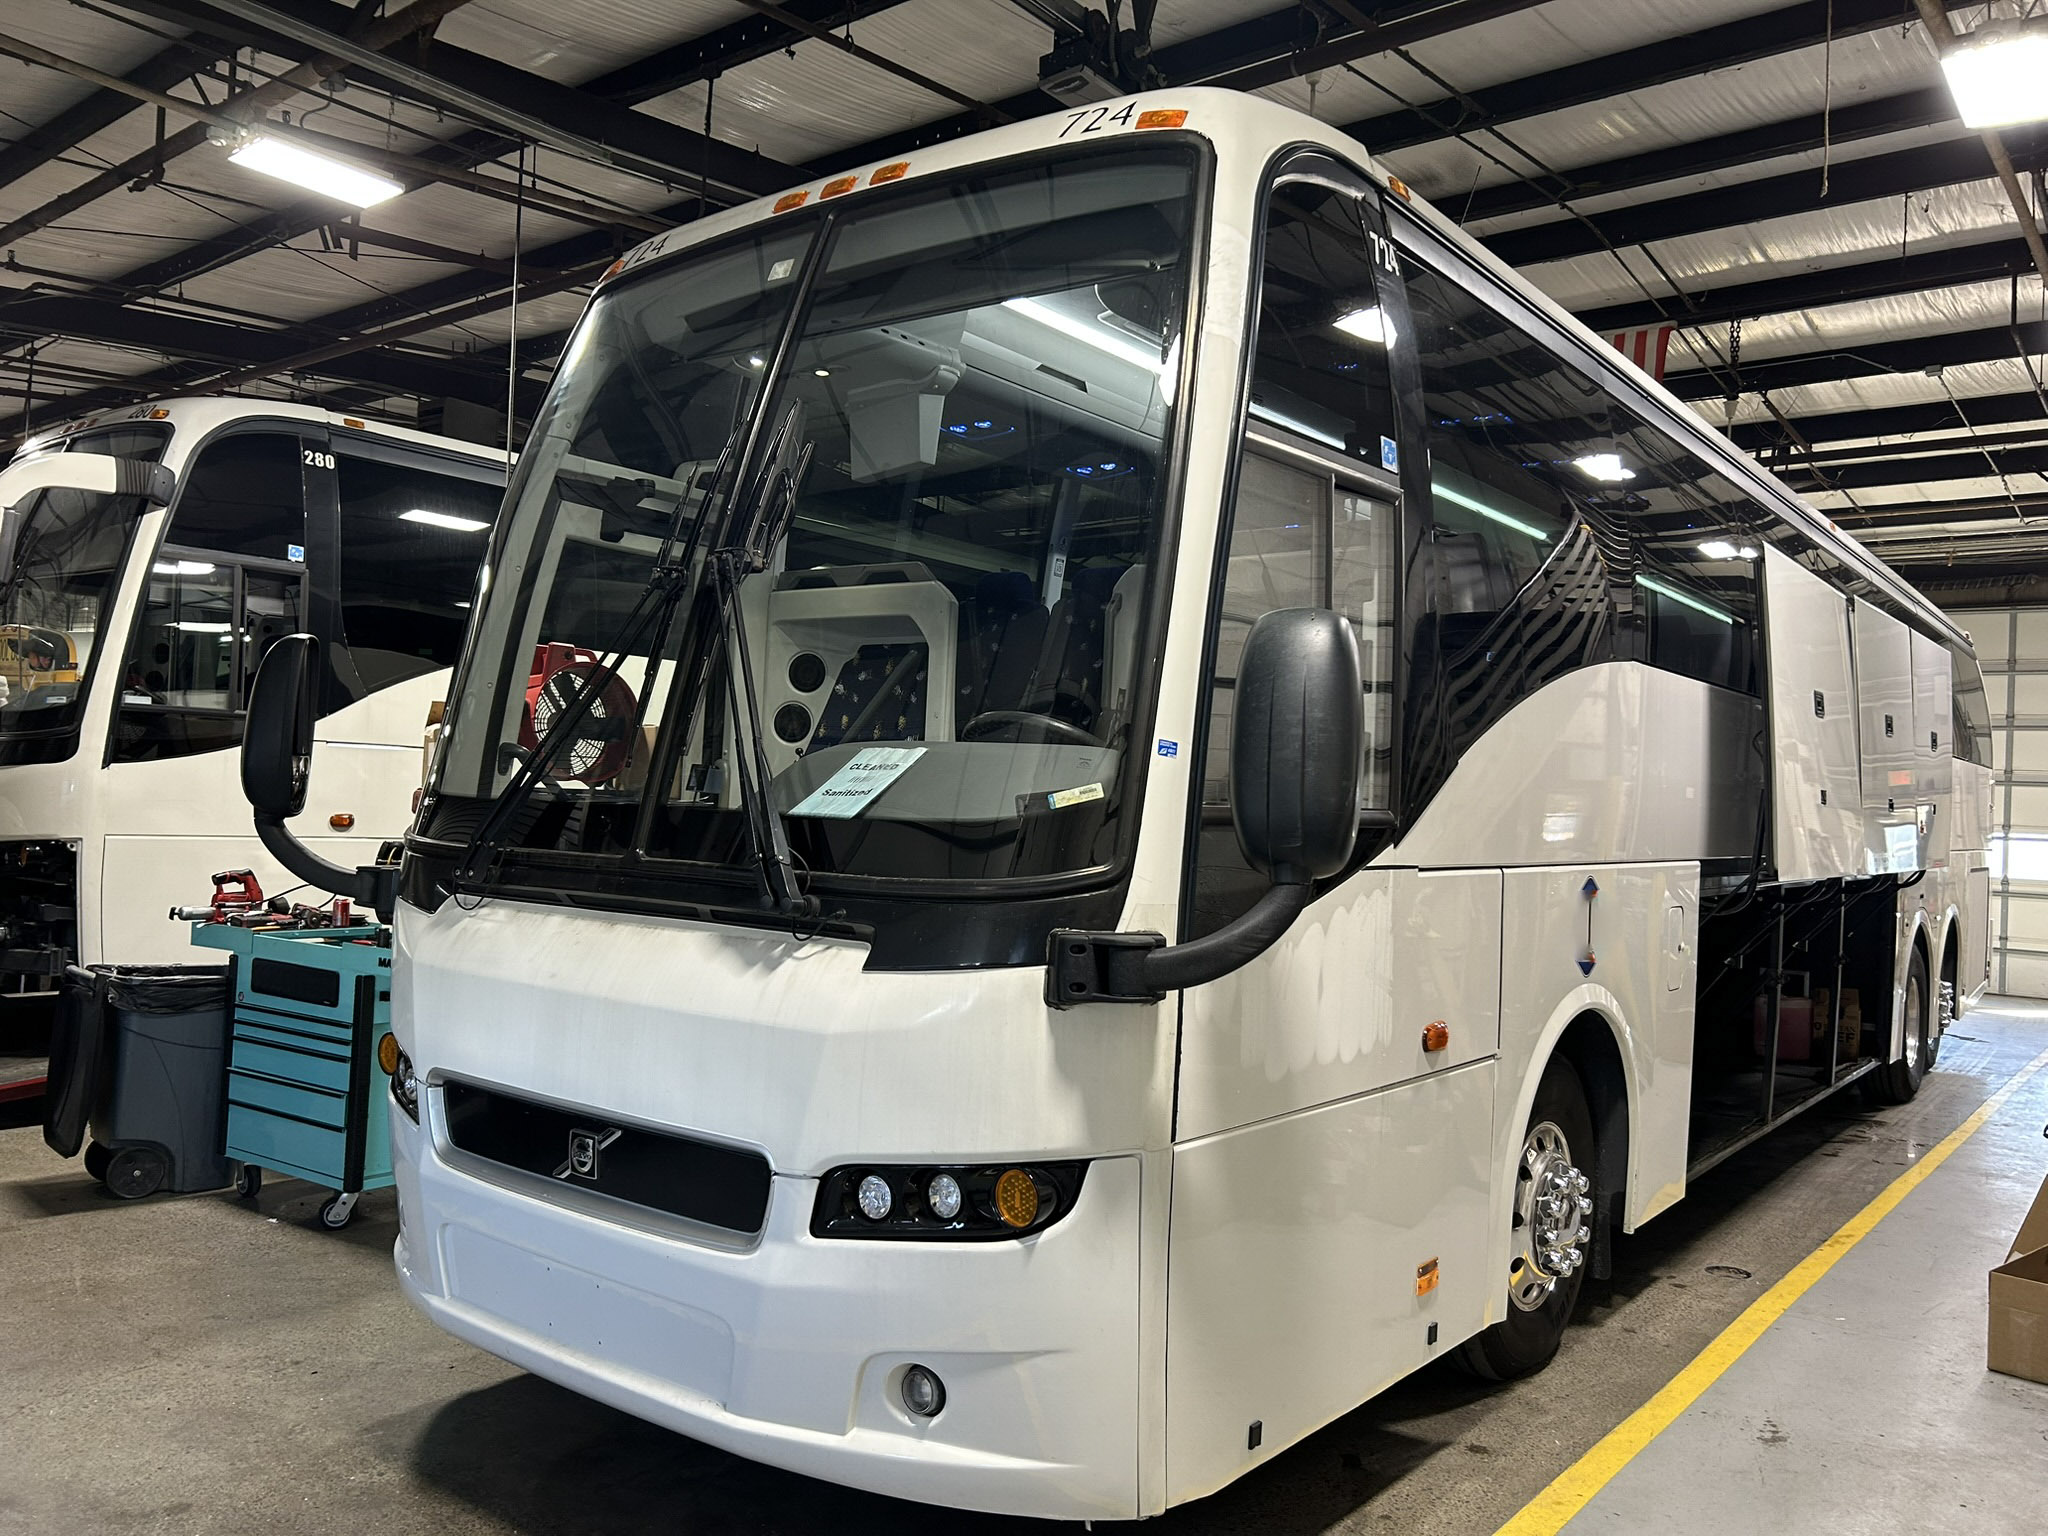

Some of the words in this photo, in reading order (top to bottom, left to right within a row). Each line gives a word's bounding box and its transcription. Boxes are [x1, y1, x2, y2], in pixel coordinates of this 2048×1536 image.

[1058, 100, 1138, 138] 724
[622, 233, 671, 270] 724
[1368, 230, 1400, 277] 724
[303, 449, 335, 470] 280
[849, 763, 900, 771] CLEANED
[821, 788, 874, 797] Sanitized
